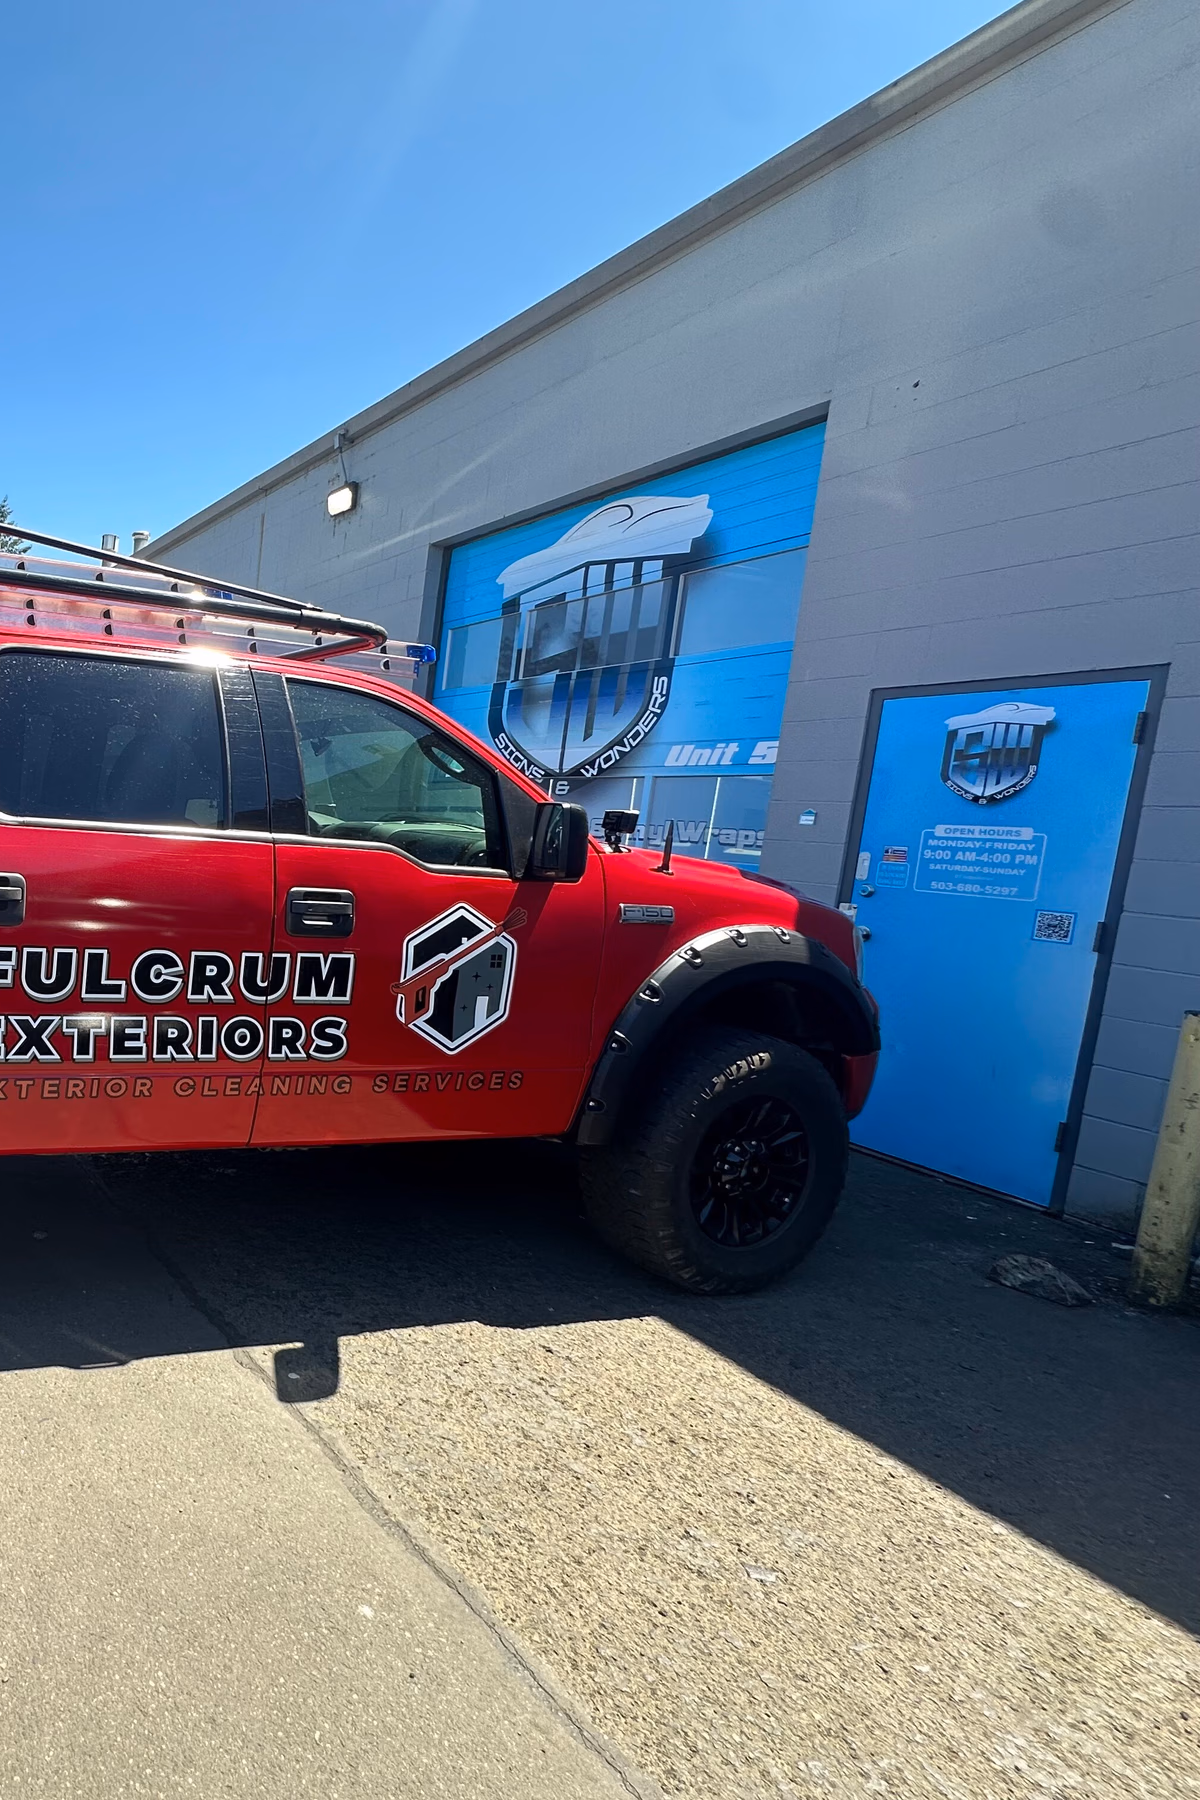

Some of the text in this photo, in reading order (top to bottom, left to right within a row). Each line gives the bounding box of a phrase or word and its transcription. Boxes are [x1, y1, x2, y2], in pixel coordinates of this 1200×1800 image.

[495, 676, 668, 796] SIGNS & WONDERS
[664, 740, 779, 767] Unit 5
[945, 780, 975, 801] SIGNS
[993, 764, 1037, 799] WONDERS
[943, 827, 1022, 838] OPEN HOURS
[927, 839, 1036, 851] MONDAY-FRIDAY
[923, 850, 1038, 865] 9:00 AM-4:00 PM
[928, 863, 1027, 876] SATURDAY-SUNDAY
[930, 881, 1018, 897] 503-680-5297
[173, 1074, 352, 1097] CLEANING
[371, 1071, 524, 1093] SERVICES
